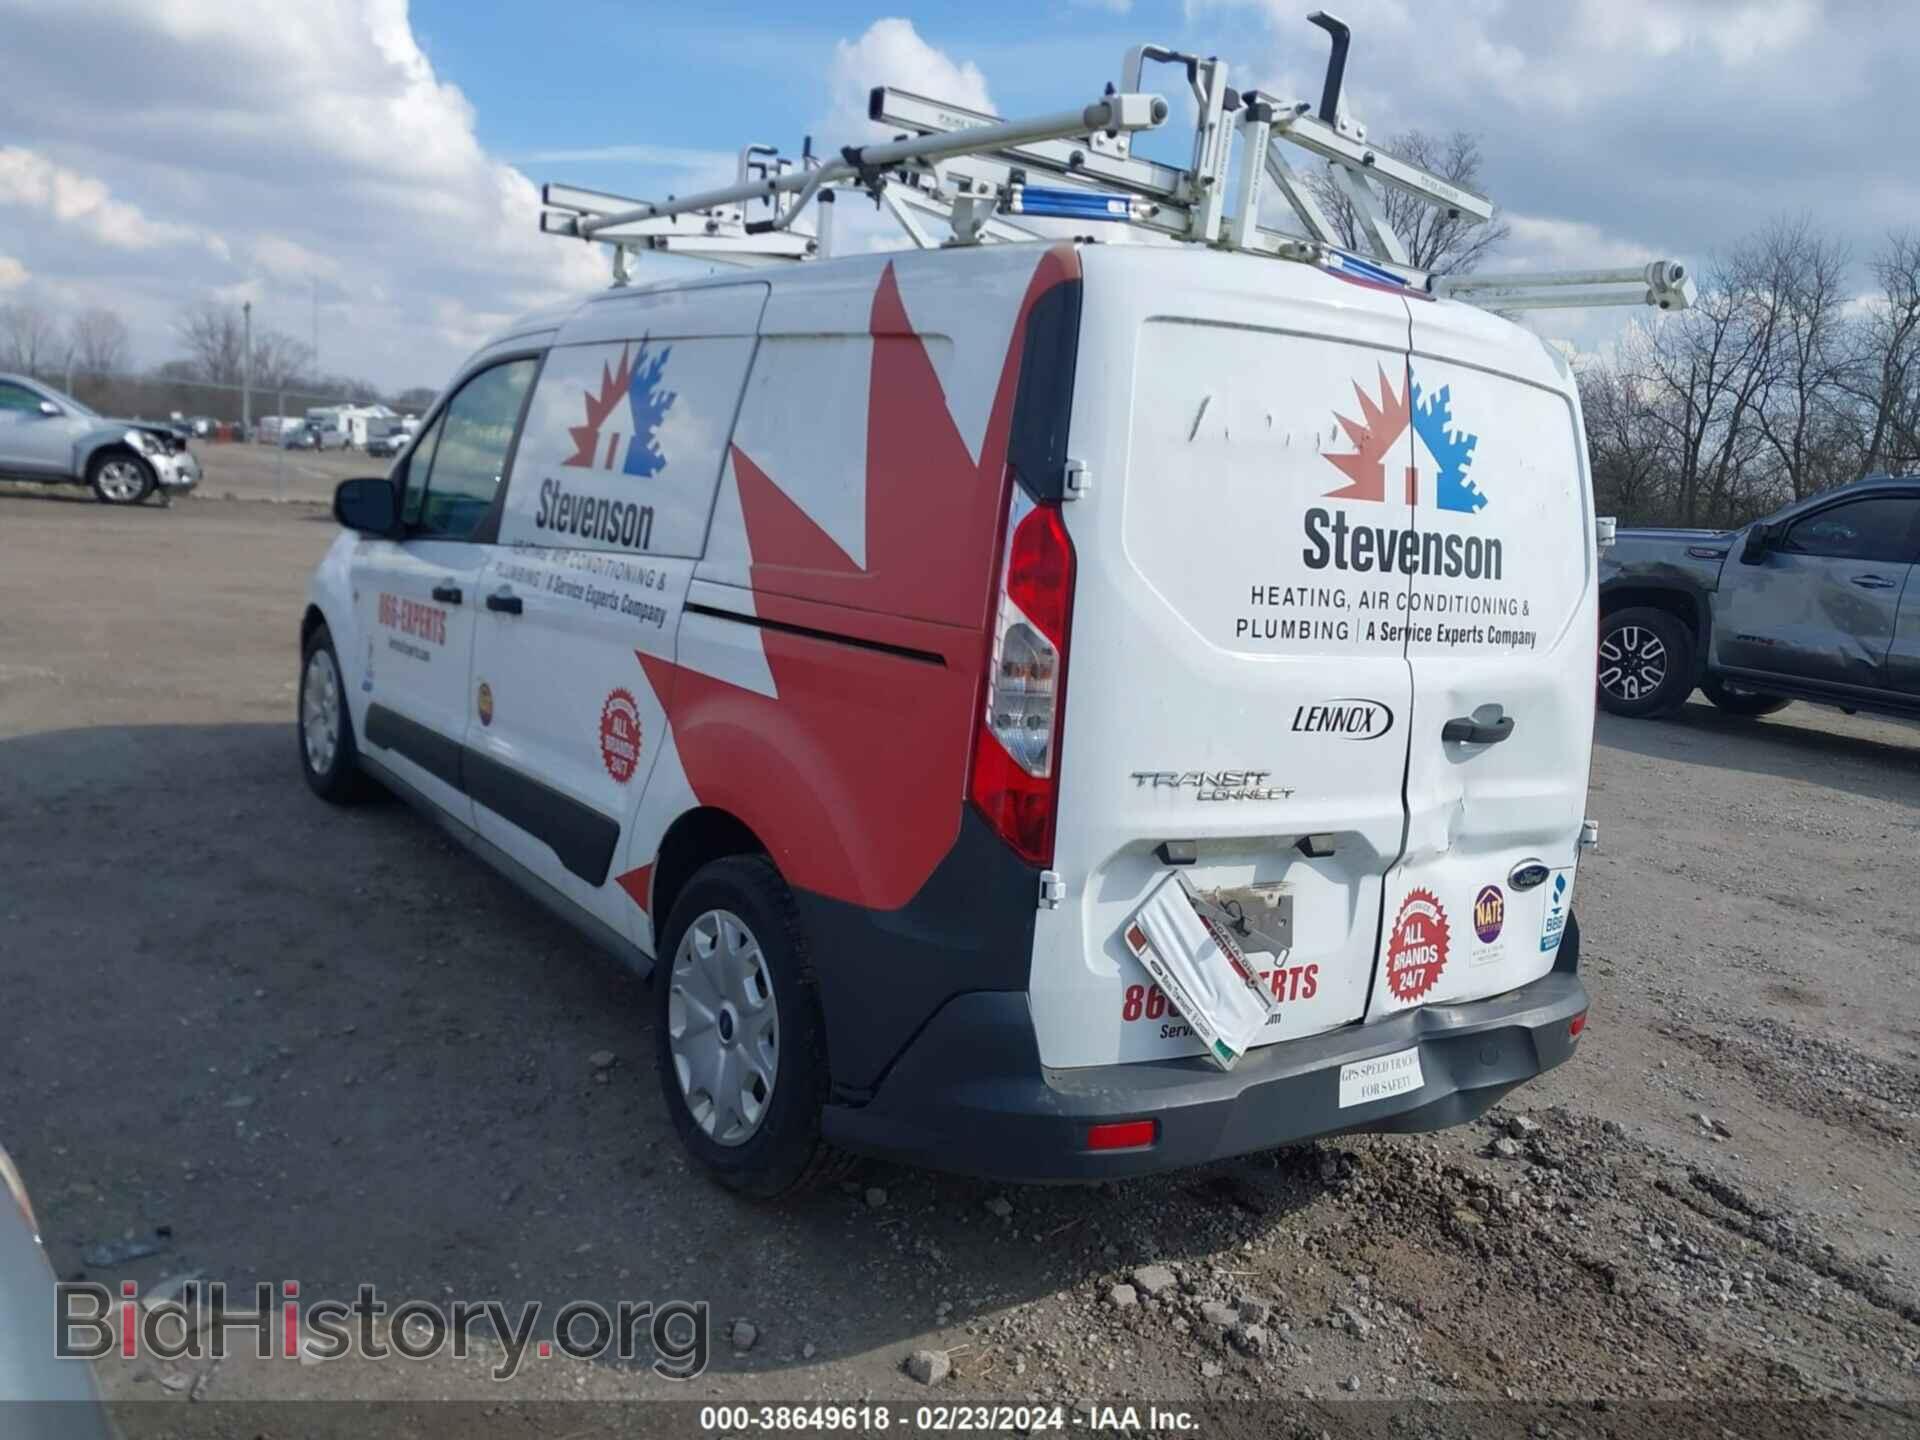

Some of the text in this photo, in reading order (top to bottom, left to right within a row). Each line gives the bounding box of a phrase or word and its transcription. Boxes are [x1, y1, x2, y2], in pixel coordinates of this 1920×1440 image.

[536, 477, 655, 550] Stevenson
[1302, 507, 1503, 580] Stevenson
[620, 593, 668, 629] Company
[1251, 585, 1531, 617] HEATING, AIR CONDITIONING &
[1235, 618, 1350, 640] PLUMBING
[1366, 621, 1537, 651] A Service Experts Company
[1291, 705, 1377, 733] LENNOX
[1130, 771, 1272, 789] TRANSIT
[1196, 786, 1297, 802] CONNECT
[1476, 900, 1503, 928] NATE
[1403, 922, 1425, 947] ALL
[1393, 943, 1439, 973] BRANDS
[1399, 969, 1426, 992] 24/7
